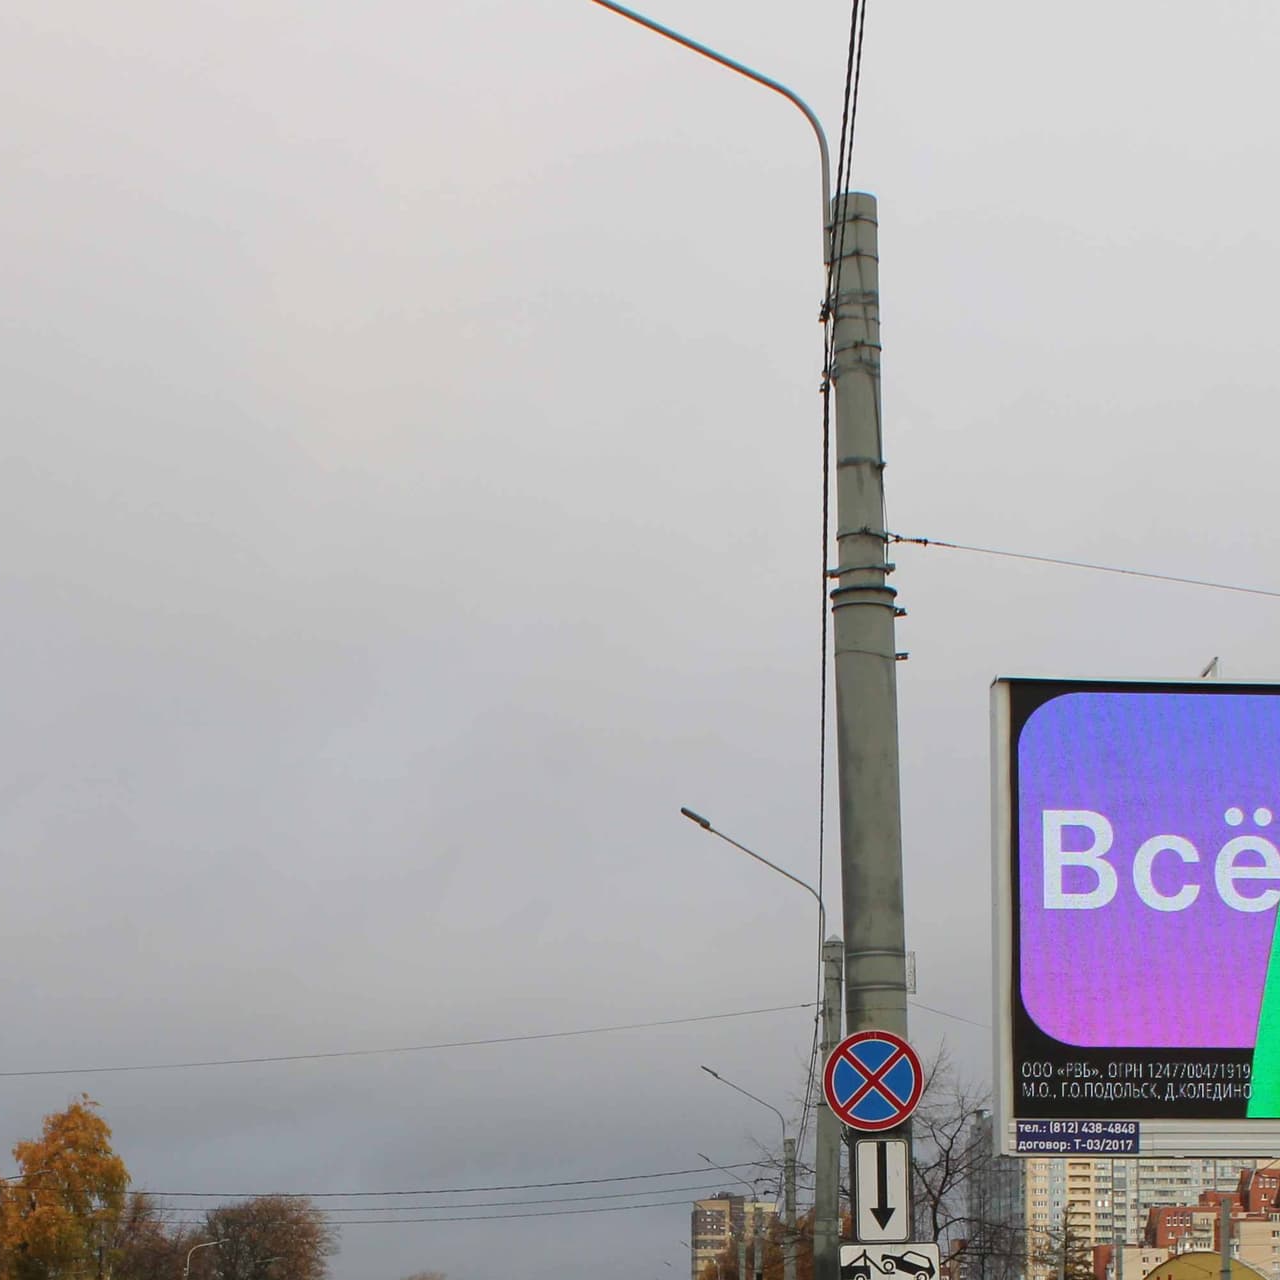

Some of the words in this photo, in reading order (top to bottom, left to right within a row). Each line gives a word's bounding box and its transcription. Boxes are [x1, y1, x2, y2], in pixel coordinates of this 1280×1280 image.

[1022, 1062, 1053, 1078] ООО
[1108, 1063, 1143, 1079] ОГРН
[1165, 1083, 1252, 1101] Д.КОЛЕДИНО
[1018, 1123, 1047, 1133] тел.:
[1049, 1122, 1078, 1134] (812)
[1081, 1123, 1136, 1134] 438-4848
[1018, 1140, 1071, 1152] договор:
[1074, 1139, 1133, 1151] Т-03/2017
